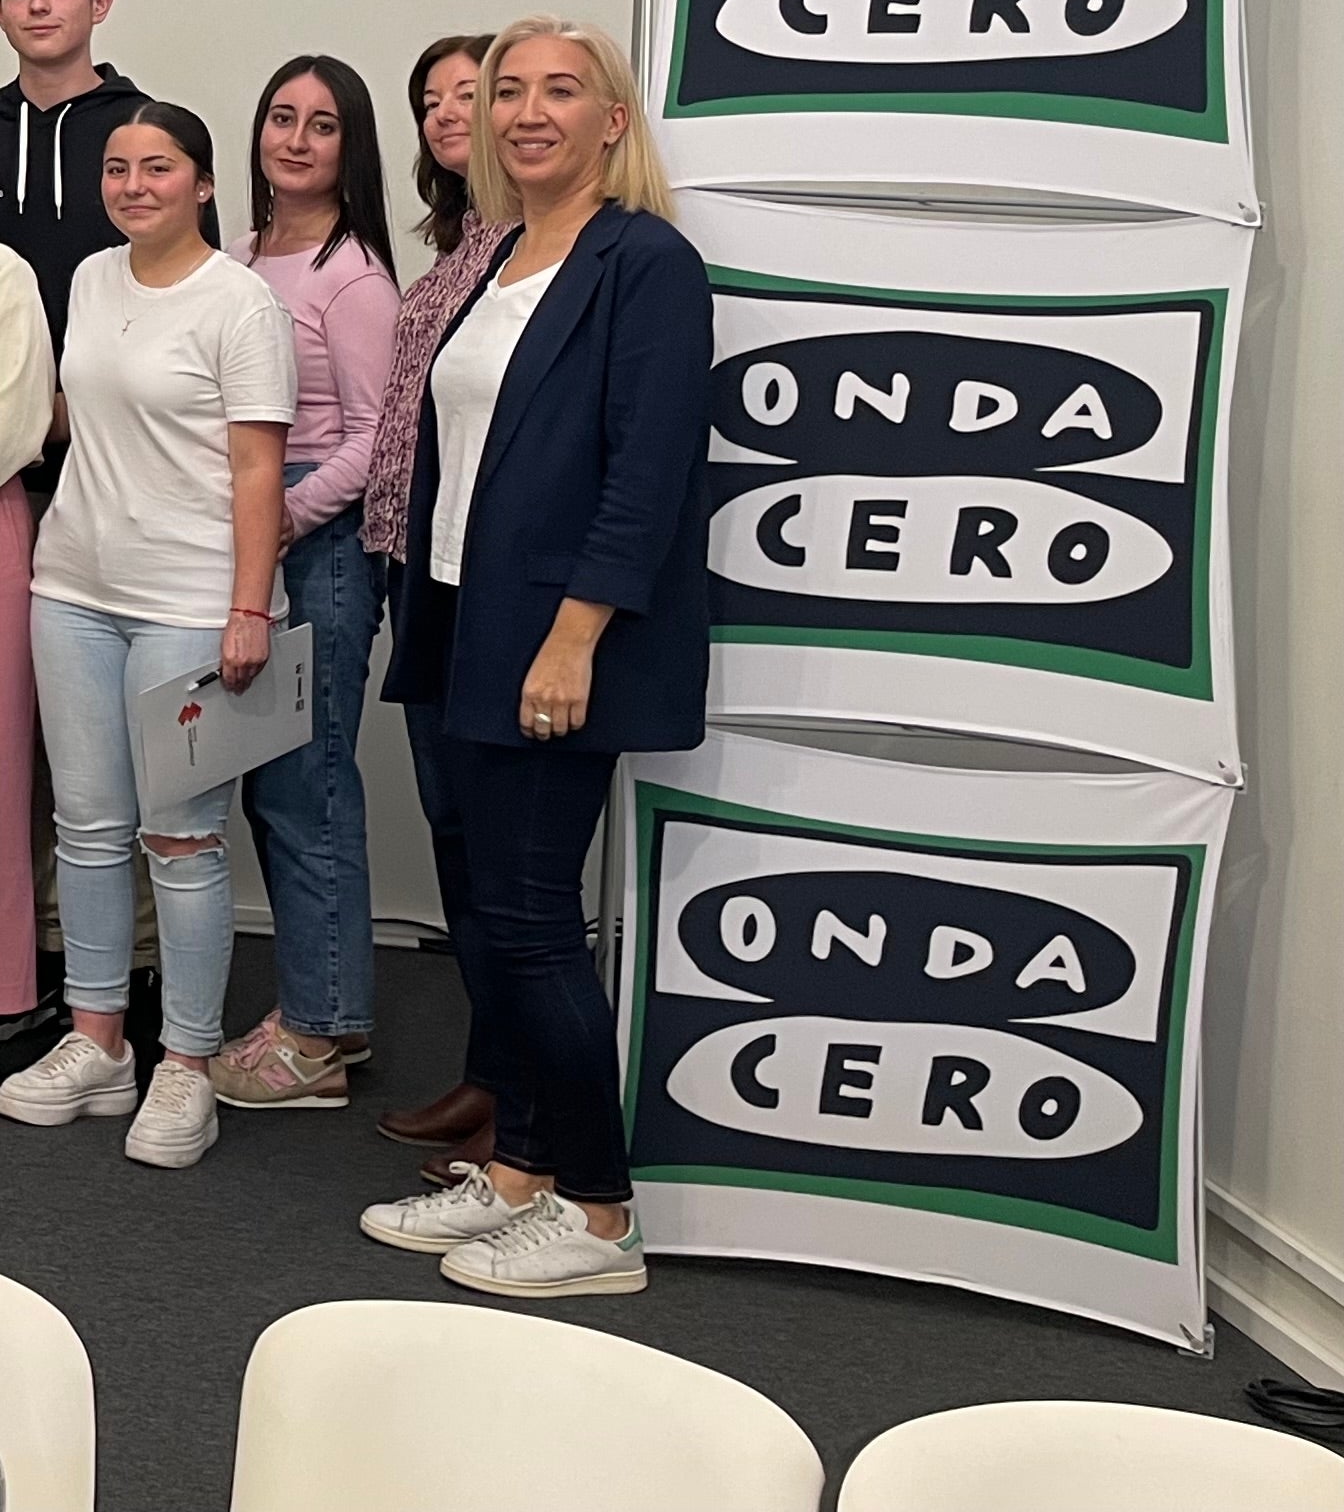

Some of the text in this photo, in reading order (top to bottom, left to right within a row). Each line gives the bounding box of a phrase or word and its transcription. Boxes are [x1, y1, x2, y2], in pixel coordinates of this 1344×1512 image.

[742, 362, 1113, 439] ONDA
[756, 493, 1110, 584] CERO
[720, 896, 1086, 993] ONDA
[730, 1033, 1082, 1141] CERO
